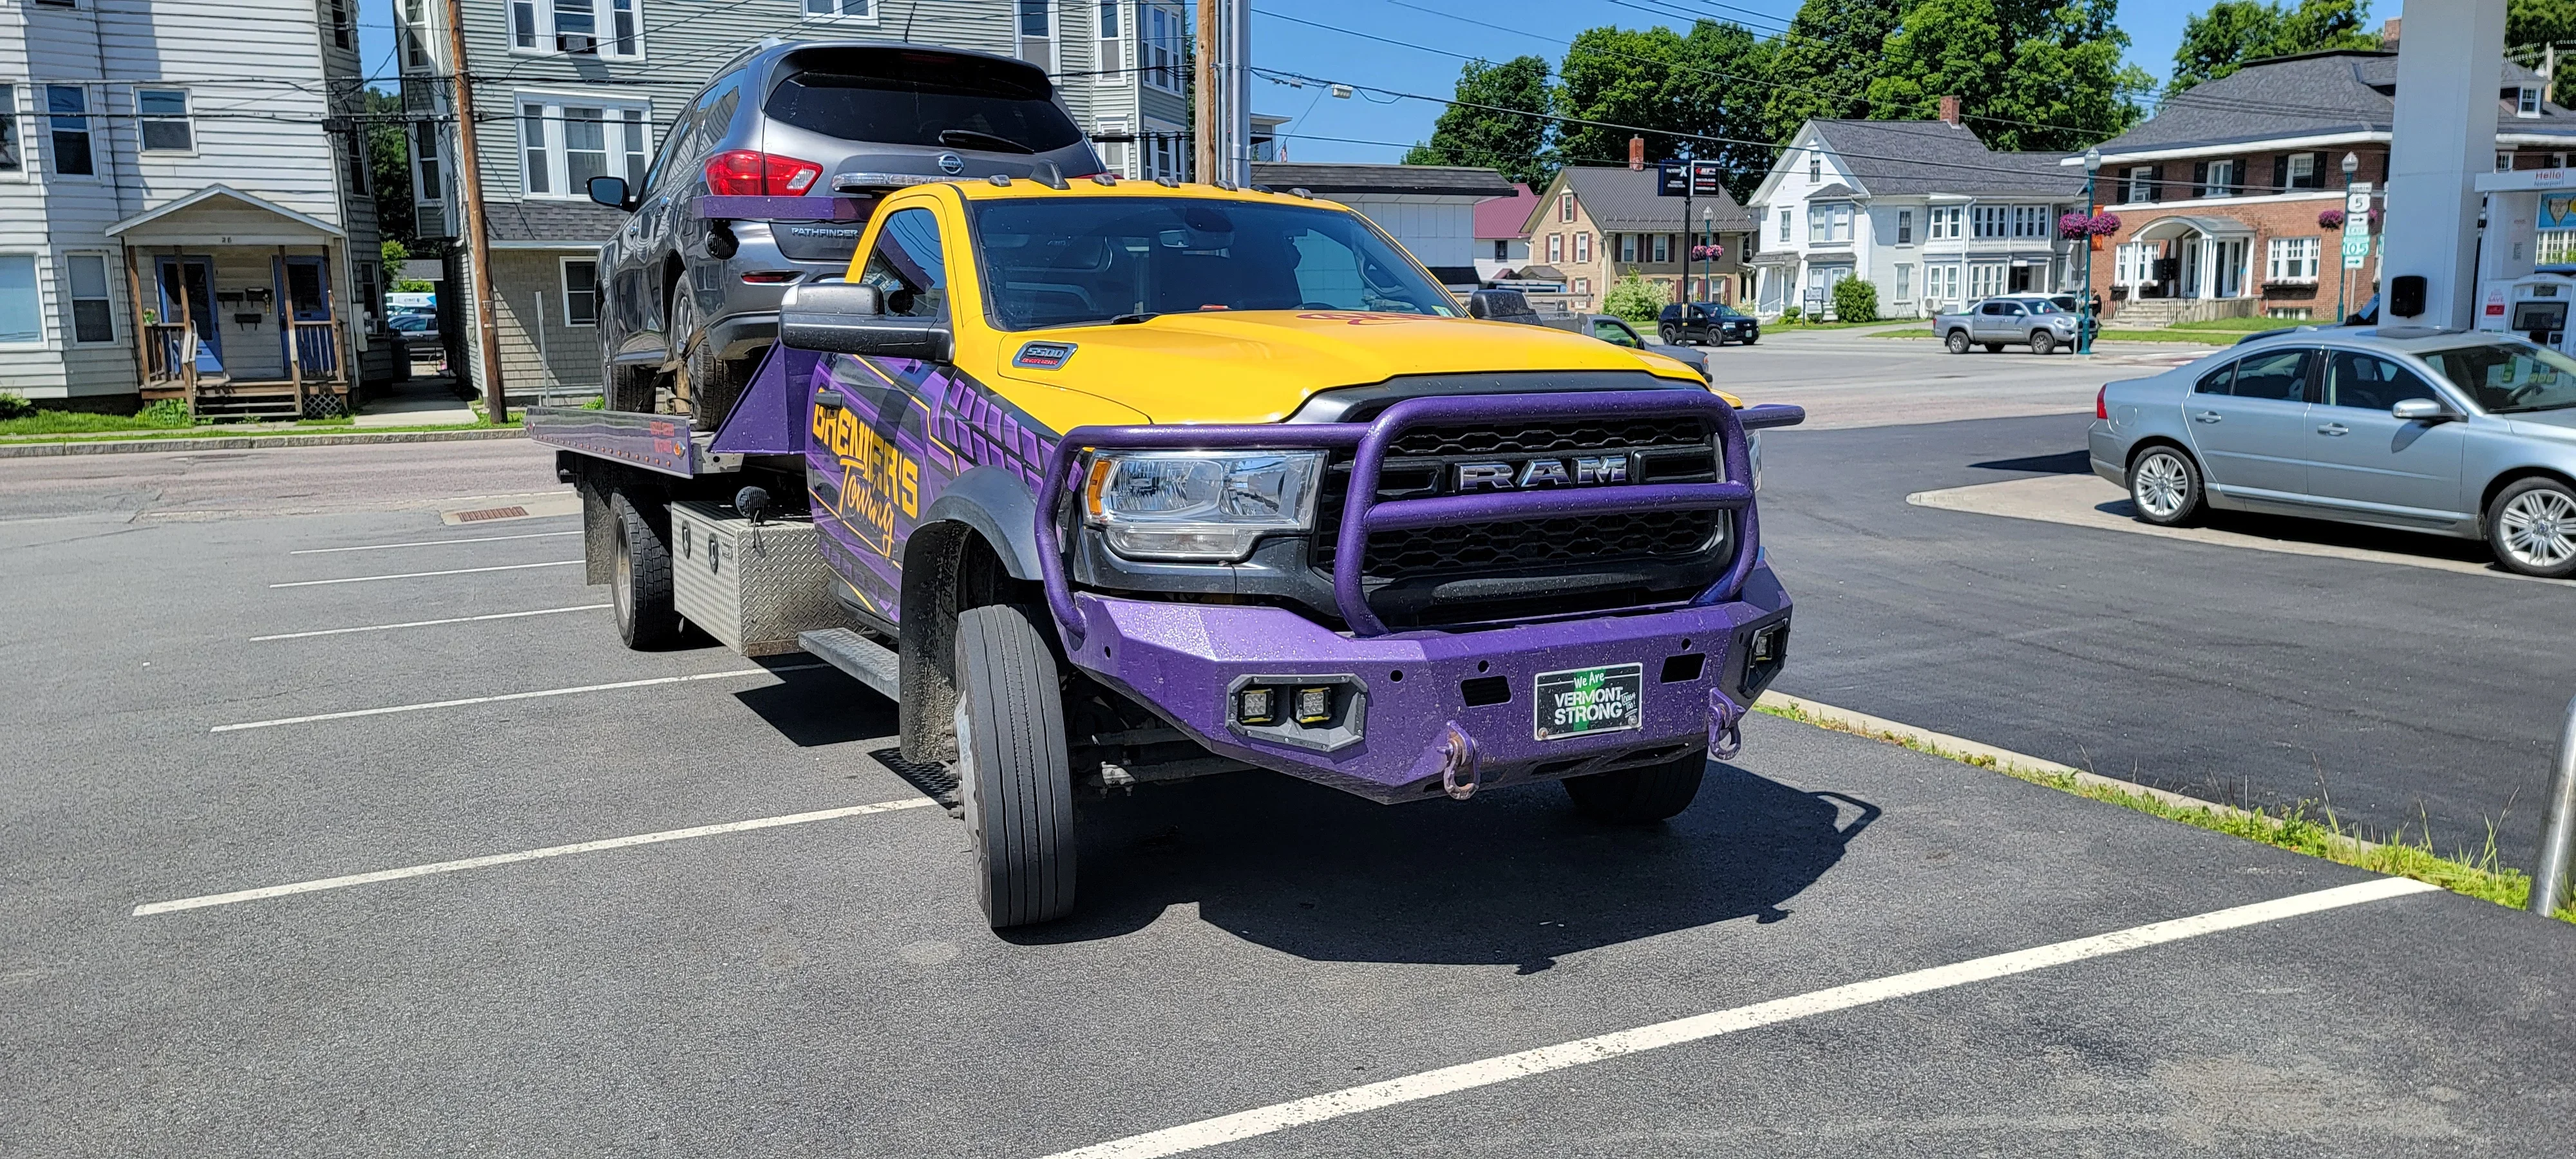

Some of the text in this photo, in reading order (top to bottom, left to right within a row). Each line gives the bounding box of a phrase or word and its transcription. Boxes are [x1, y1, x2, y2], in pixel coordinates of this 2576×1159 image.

[2535, 170, 2564, 180] Hello!
[2355, 197, 2363, 207] 5
[791, 227, 859, 238] PATHFINDER
[2344, 243, 2366, 254] 105
[1027, 347, 1065, 358] 5500
[1454, 456, 1627, 491] RAM
[839, 457, 895, 560] Towing
[1573, 671, 1605, 688] We Are
[1554, 686, 1624, 708] VERMONT
[1554, 701, 1623, 725] STRONG
